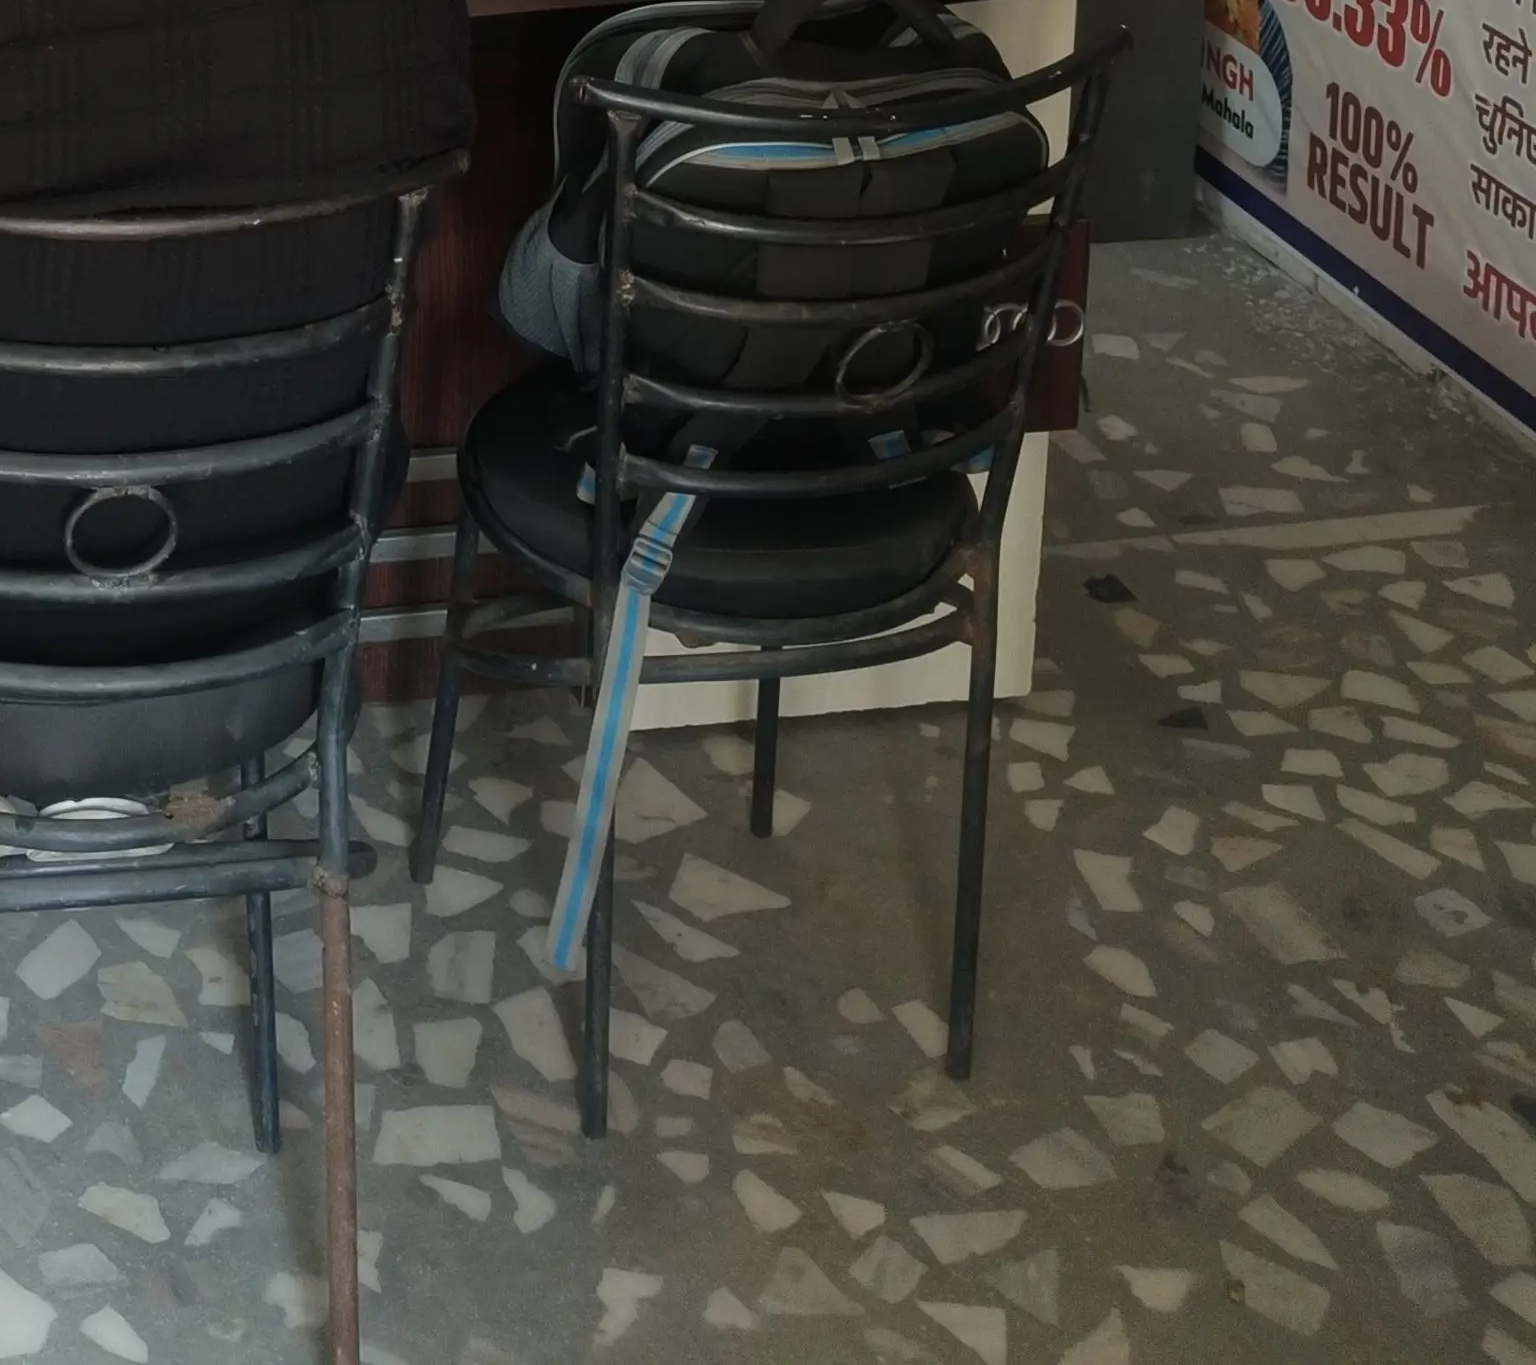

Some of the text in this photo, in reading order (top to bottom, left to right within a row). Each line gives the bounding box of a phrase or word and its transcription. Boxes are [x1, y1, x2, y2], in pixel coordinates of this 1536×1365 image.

[1482, 22, 1532, 85] रहने
[1202, 80, 1254, 139] Mahala
[1326, 82, 1419, 194] 100%
[1307, 131, 1434, 270] RESULT
